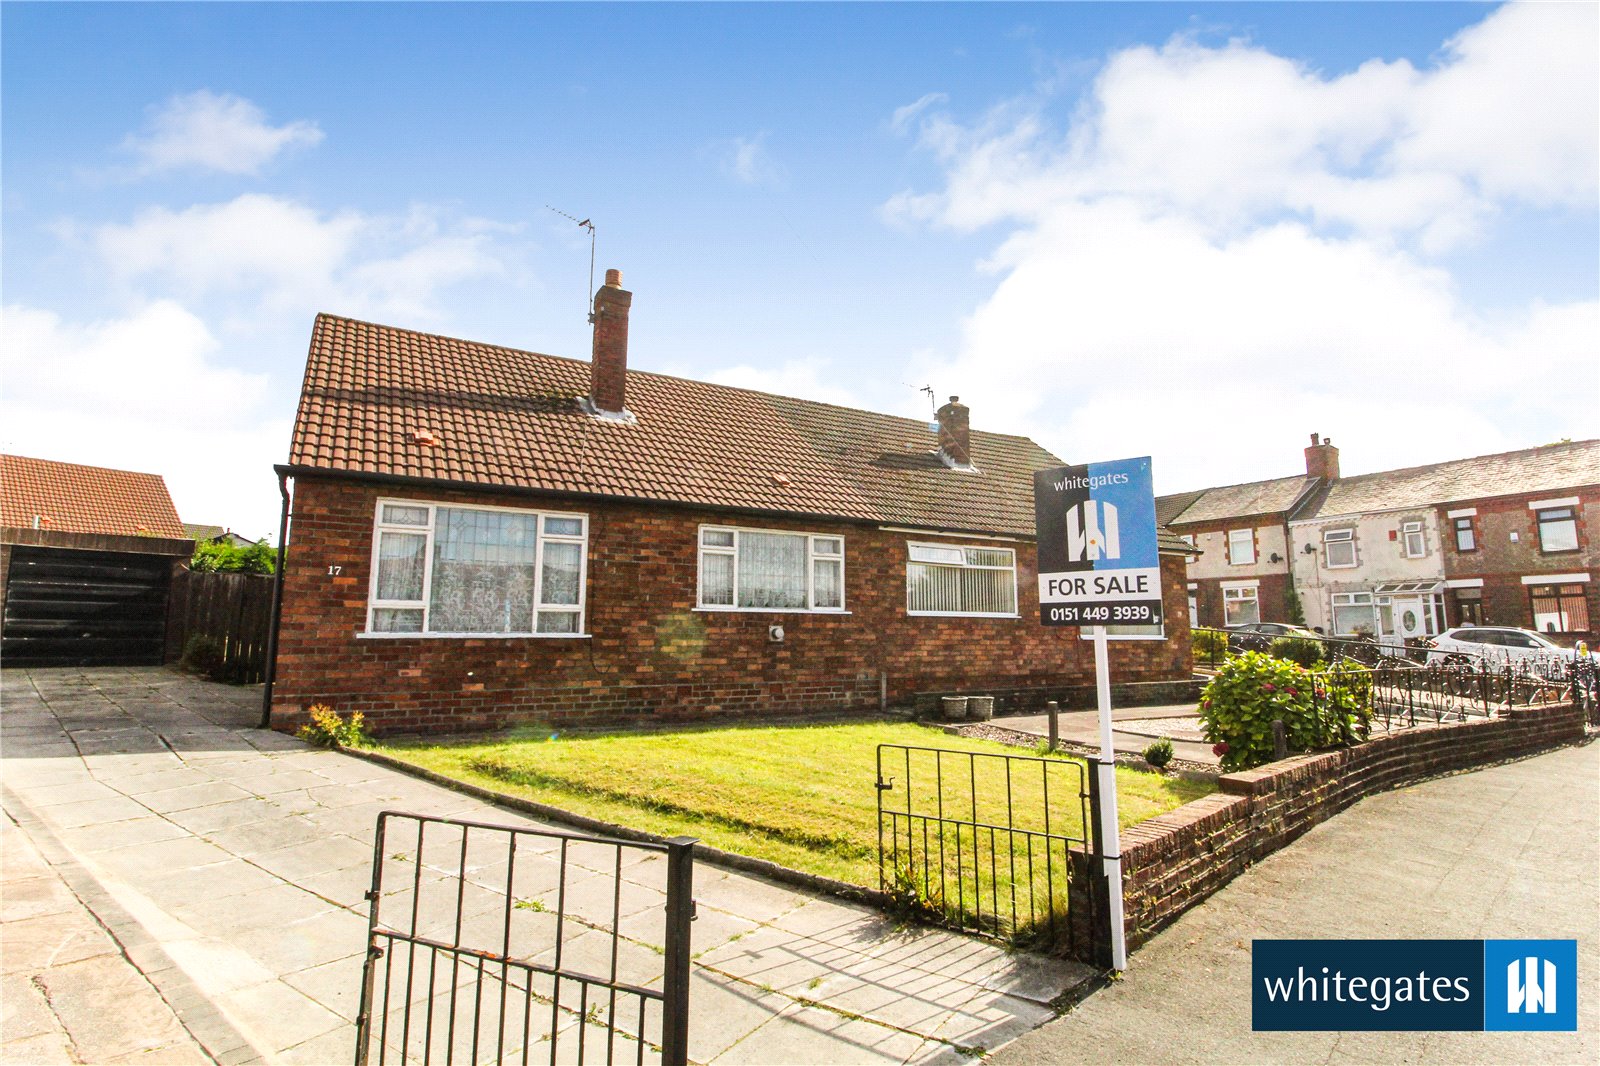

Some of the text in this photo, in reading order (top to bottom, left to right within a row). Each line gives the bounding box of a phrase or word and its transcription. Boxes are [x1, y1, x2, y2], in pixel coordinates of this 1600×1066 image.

[1054, 472, 1128, 491] whitegates
[327, 565, 342, 575] 17
[1048, 575, 1149, 596] FOR SALE
[1050, 605, 1149, 621] 0151 449 3939
